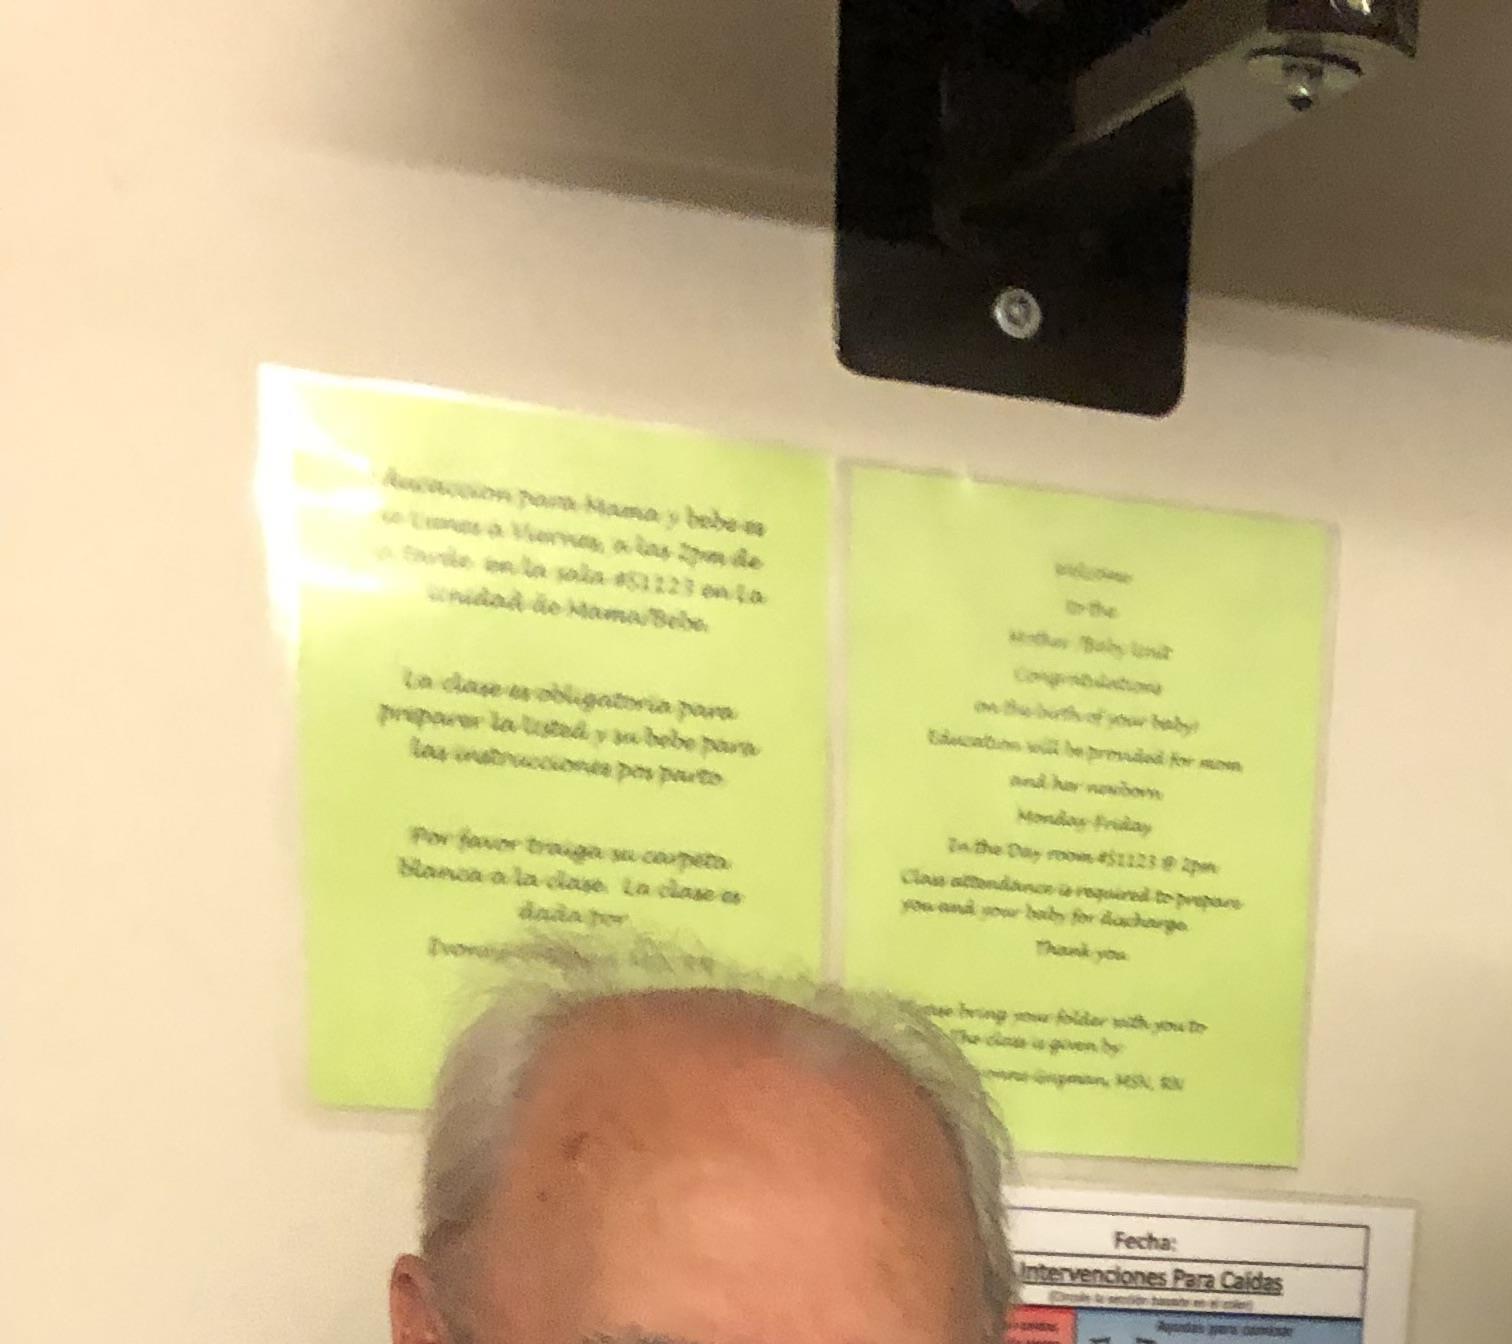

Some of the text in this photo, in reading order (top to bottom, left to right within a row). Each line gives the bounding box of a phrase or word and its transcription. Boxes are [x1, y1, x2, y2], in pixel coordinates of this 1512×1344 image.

[519, 489, 575, 512] para
[636, 534, 670, 560] las
[732, 547, 764, 570] de
[485, 557, 514, 576] en
[521, 554, 547, 580] la
[556, 563, 604, 586] sala
[702, 583, 729, 601] en
[736, 583, 766, 606] la
[532, 592, 562, 616] de
[403, 666, 433, 691] La
[441, 672, 501, 698] clase
[508, 684, 531, 701] es
[677, 700, 738, 724] para
[1106, 713, 1148, 733] your
[409, 736, 447, 762] las
[595, 727, 608, 748] y
[613, 728, 640, 747] su
[644, 726, 696, 750] bebe
[701, 735, 761, 760] para
[928, 727, 1022, 752] Education
[1026, 738, 1059, 756] will
[1086, 744, 1164, 766] provided
[1168, 751, 1196, 768] for
[1010, 773, 1047, 791] and
[1052, 772, 1083, 793] her
[410, 825, 448, 846] Por
[458, 825, 520, 853] favor
[527, 837, 603, 865] traiga
[610, 848, 638, 864] su
[973, 838, 1002, 857] the
[1007, 841, 1041, 864] Day
[490, 869, 507, 886] a
[514, 865, 537, 888] la
[622, 876, 650, 897] La
[657, 878, 716, 903] clase
[720, 890, 745, 906] es
[900, 867, 1244, 912] Class attendance is required to prepare
[588, 908, 630, 928] por
[900, 898, 935, 916] you
[937, 898, 975, 917] and
[979, 905, 1023, 922] your
[1025, 902, 1066, 925] baby
[1070, 907, 1094, 926] for
[1035, 939, 1090, 959] Thank
[959, 1001, 1008, 1027] bring
[1056, 1008, 1107, 1027] folder
[1112, 1013, 1149, 1031] with
[1150, 1019, 1185, 1036] you
[984, 1033, 1026, 1049] class
[1030, 1039, 1046, 1051] is
[1048, 1038, 1098, 1056] given
[1113, 1230, 1178, 1251] Fecha:
[1020, 1261, 1167, 1288] Intervenciones
[1173, 1268, 1216, 1289] Para
